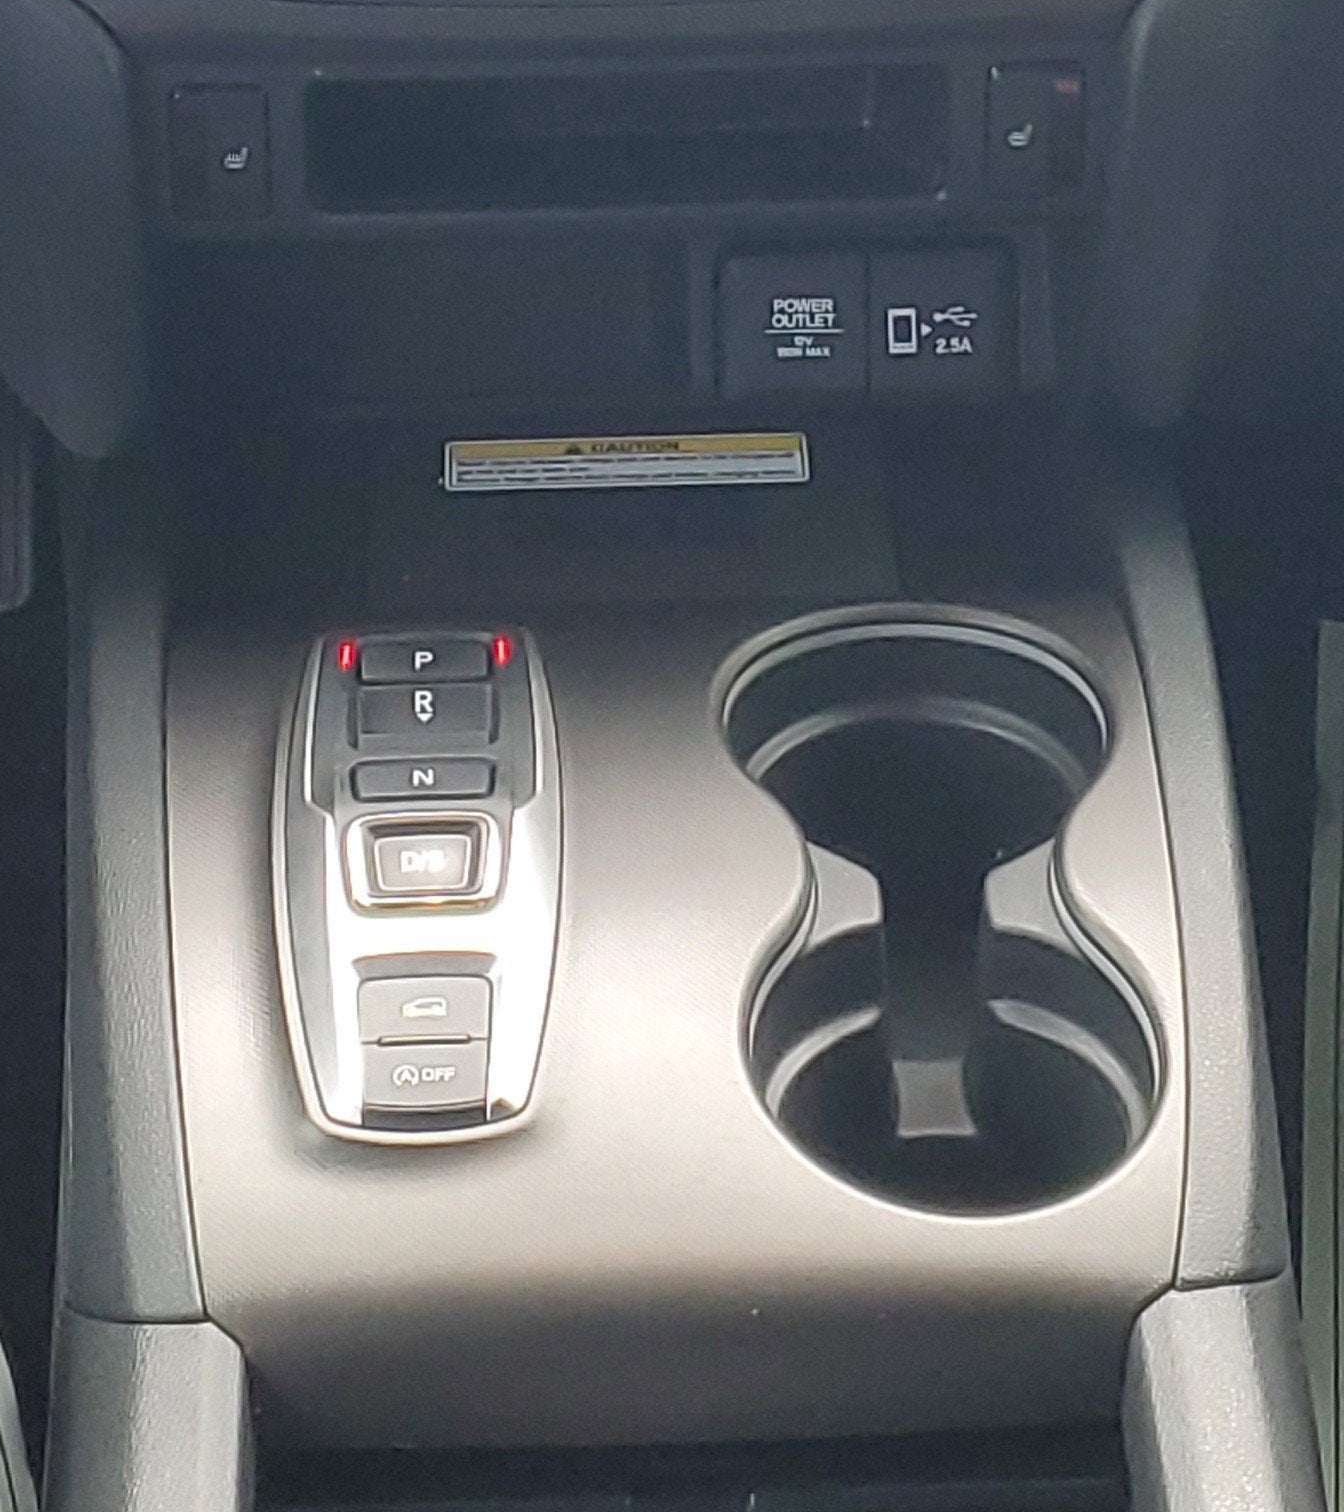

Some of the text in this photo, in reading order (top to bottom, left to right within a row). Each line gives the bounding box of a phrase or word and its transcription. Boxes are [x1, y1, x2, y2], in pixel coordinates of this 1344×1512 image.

[773, 299, 834, 313] POWER
[771, 314, 836, 328] OUTLET
[414, 651, 434, 670] P
[414, 690, 434, 713] R
[412, 769, 435, 787] N
[421, 1067, 456, 1081] OFF
